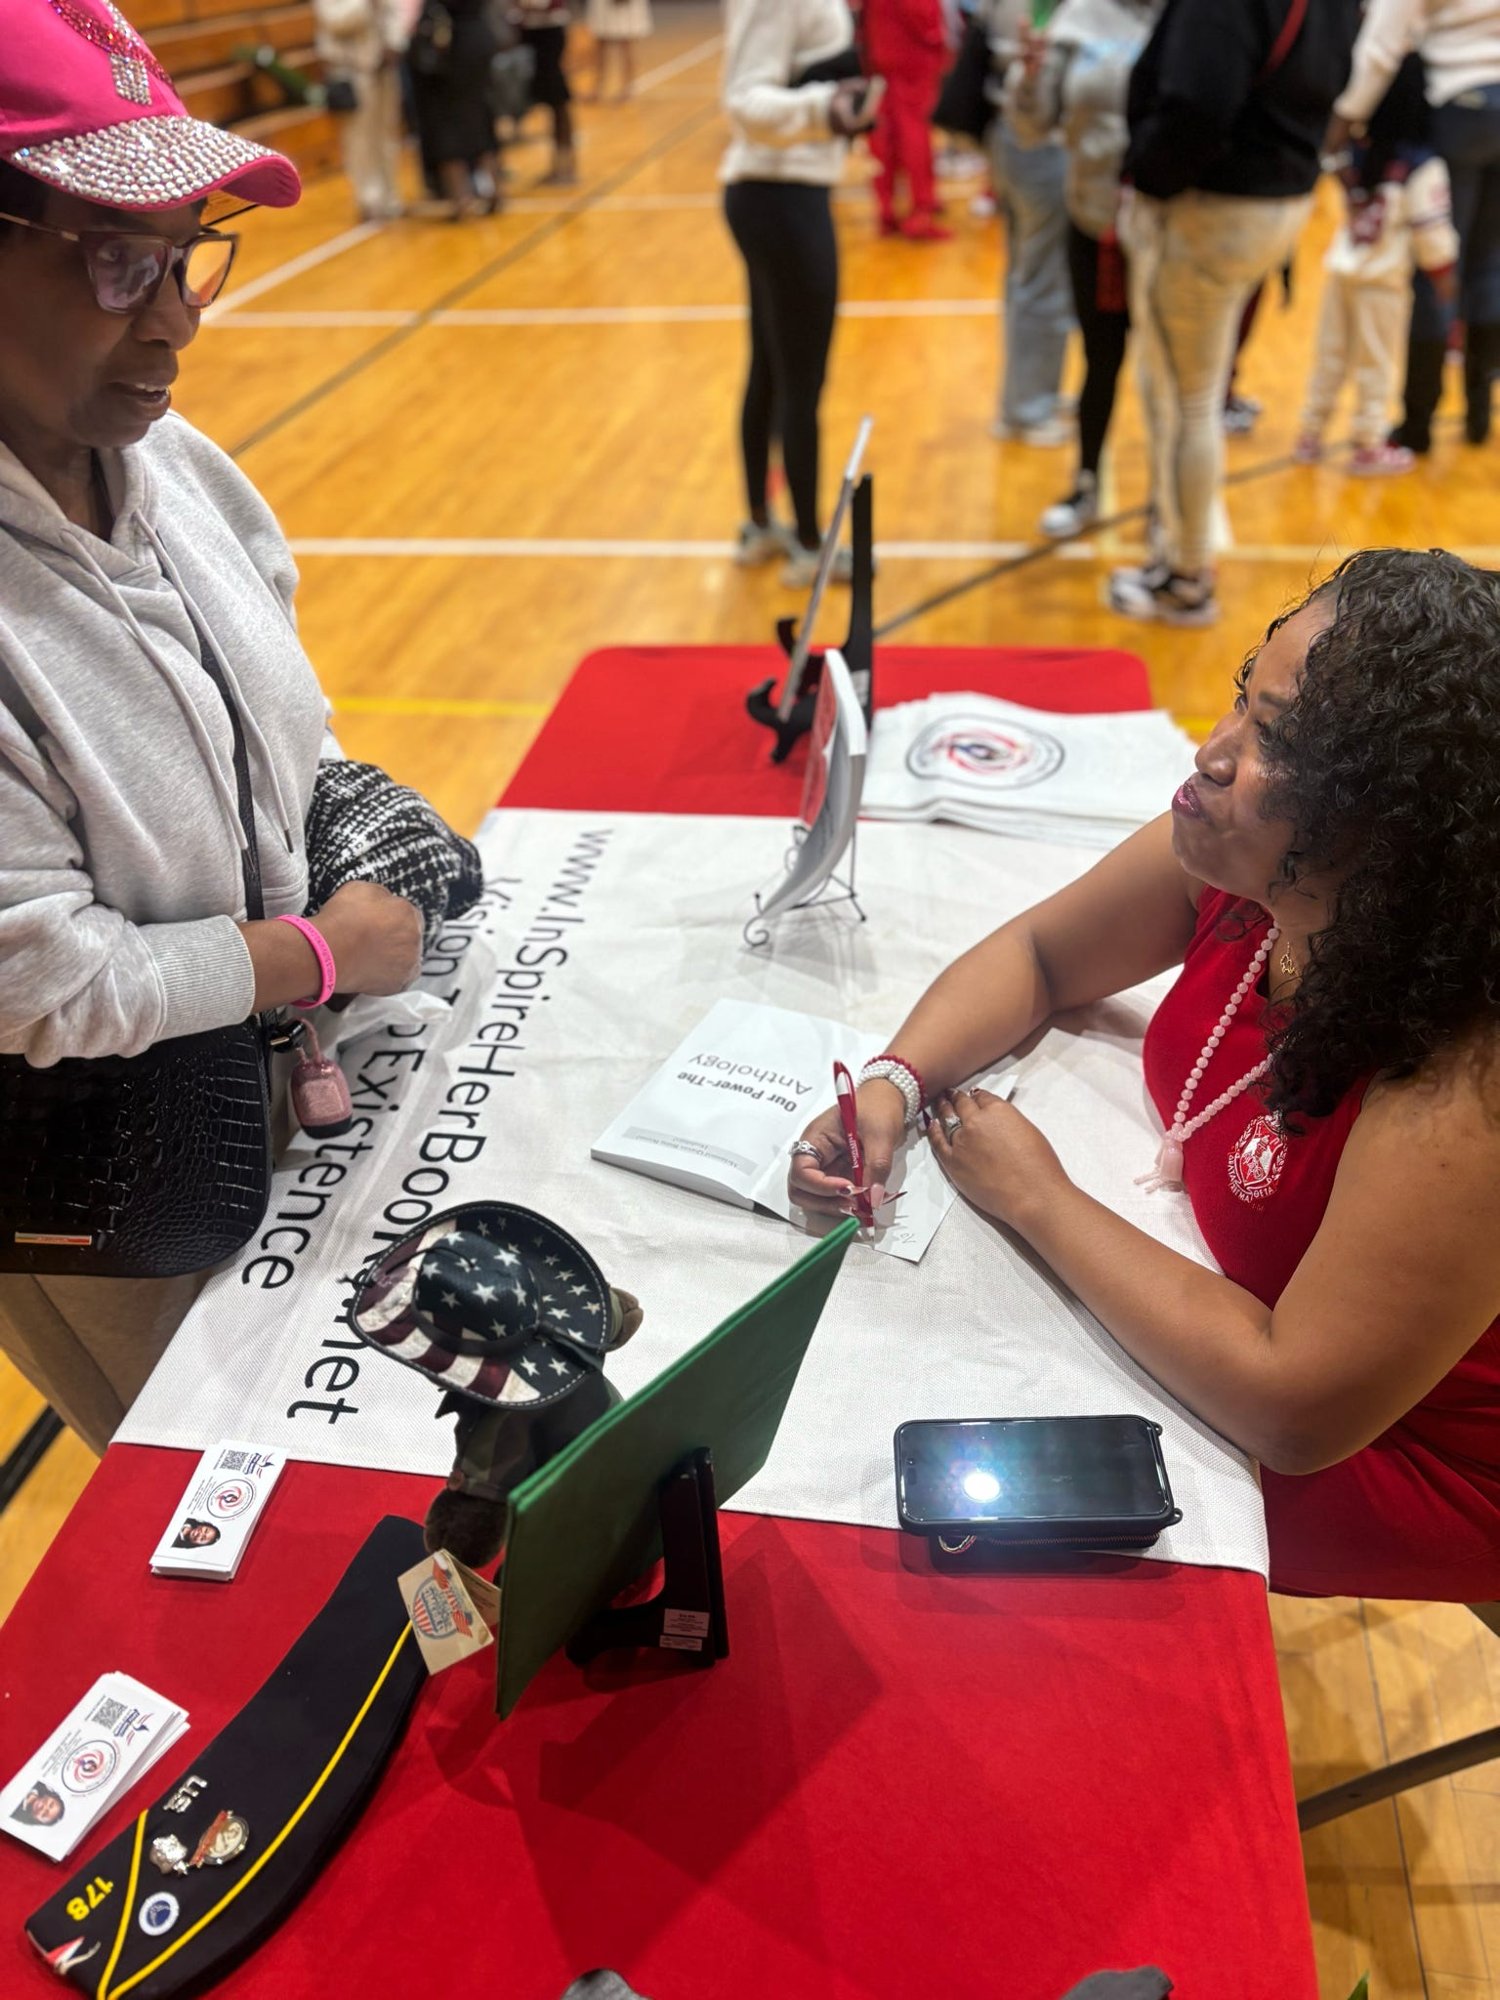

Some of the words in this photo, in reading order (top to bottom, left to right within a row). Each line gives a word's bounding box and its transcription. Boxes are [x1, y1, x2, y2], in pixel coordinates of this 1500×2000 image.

[677, 1070, 763, 1100] Power-The
[689, 1053, 813, 1097] Anthology
[766, 1092, 798, 1113] Our
[66, 1876, 114, 1921] 178
